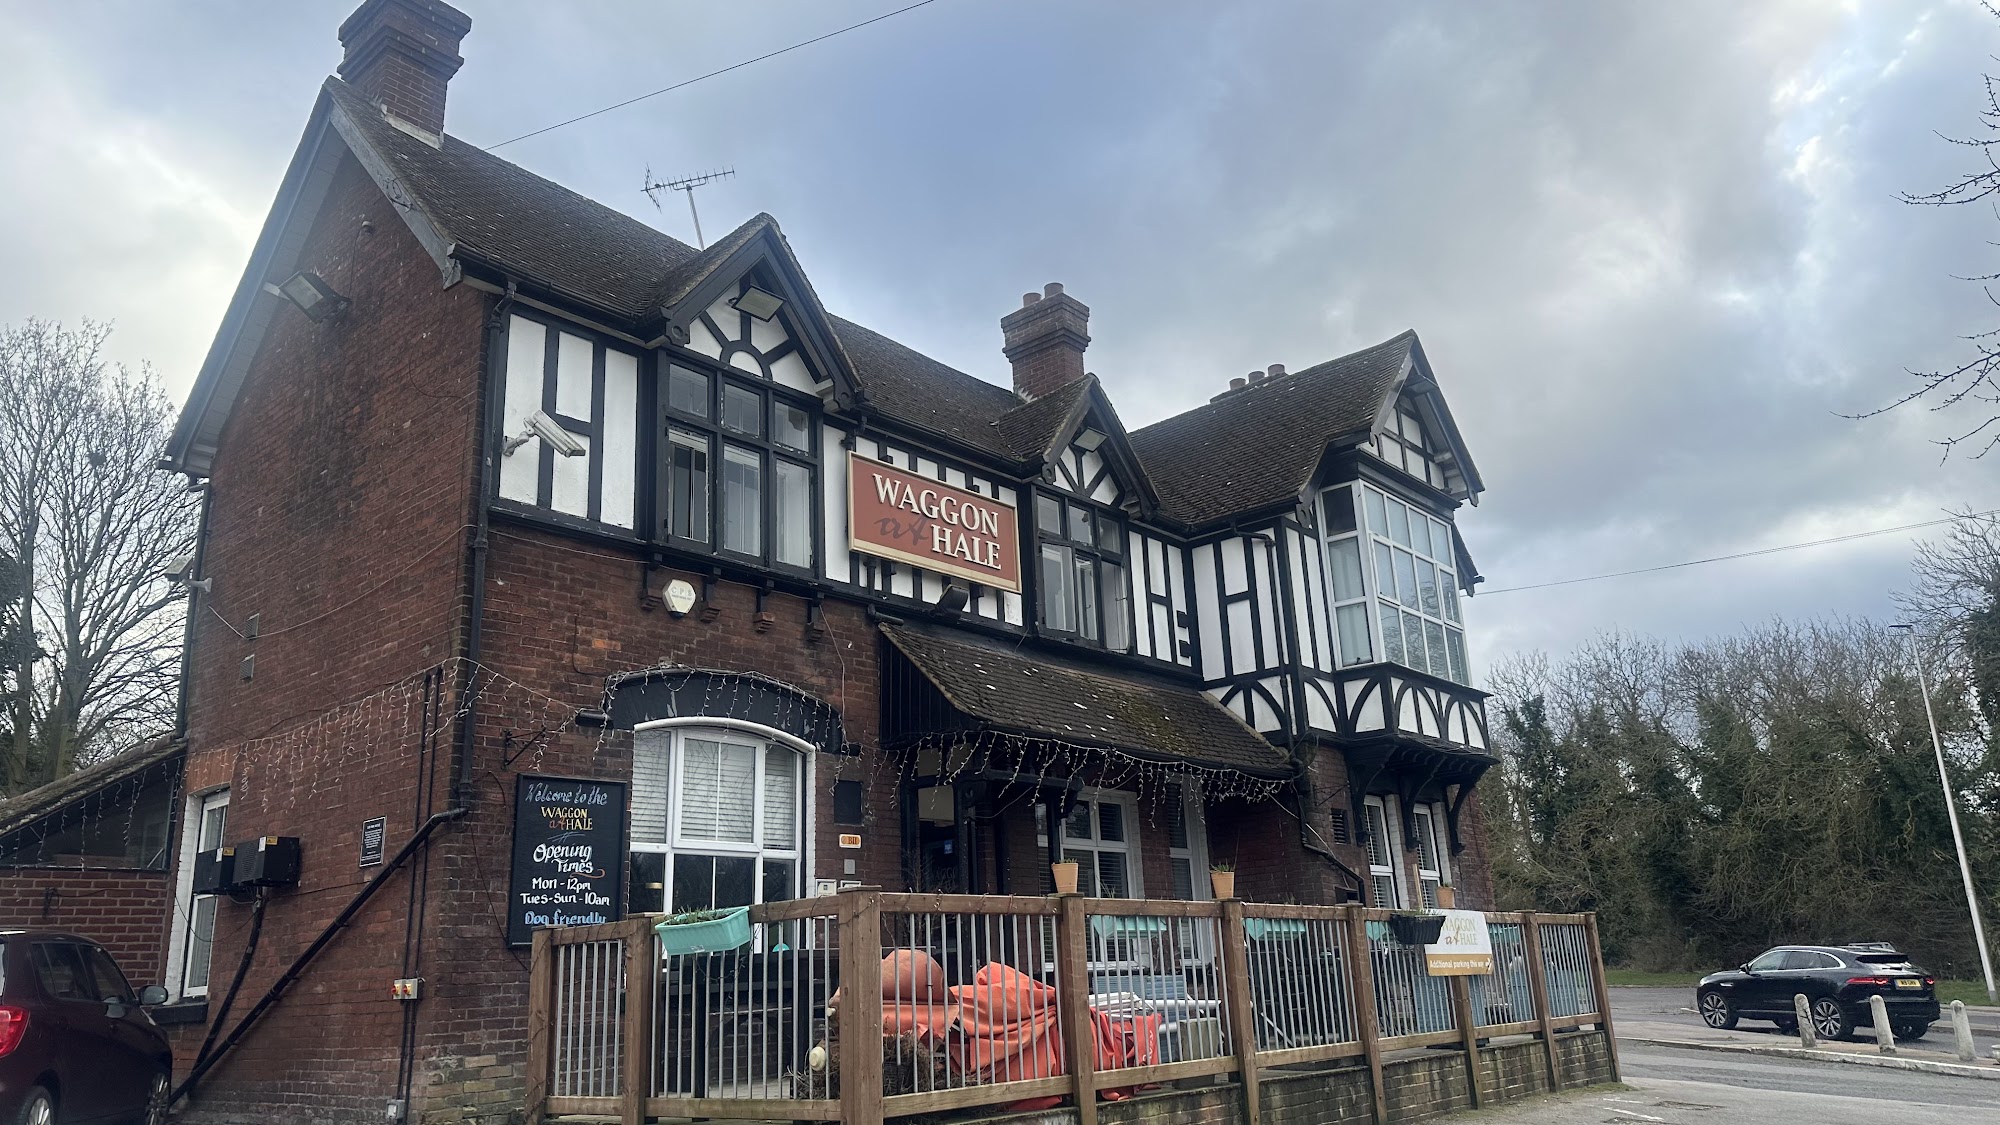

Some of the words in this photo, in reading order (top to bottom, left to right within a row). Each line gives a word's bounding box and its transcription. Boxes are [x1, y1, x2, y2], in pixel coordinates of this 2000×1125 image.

[873, 473, 998, 537] WAGGON
[874, 506, 930, 546] at
[931, 524, 1002, 570] HALE
[525, 782, 571, 803] Welcome
[574, 784, 587, 805] to
[587, 785, 608, 806] the
[540, 806, 588, 819] WAGGON
[549, 816, 566, 831] at
[566, 818, 593, 831] HALE
[533, 843, 593, 864] Opening
[551, 857, 594, 874] Times
[532, 877, 557, 890] Mon
[566, 877, 591, 893] 12pm
[584, 892, 610, 906] 10am
[525, 910, 549, 926] Dog
[553, 908, 607, 926] friendly
[1460, 932, 1478, 945] HALE
[1430, 960, 1453, 969] Additional
[1453, 960, 1470, 970] parking
